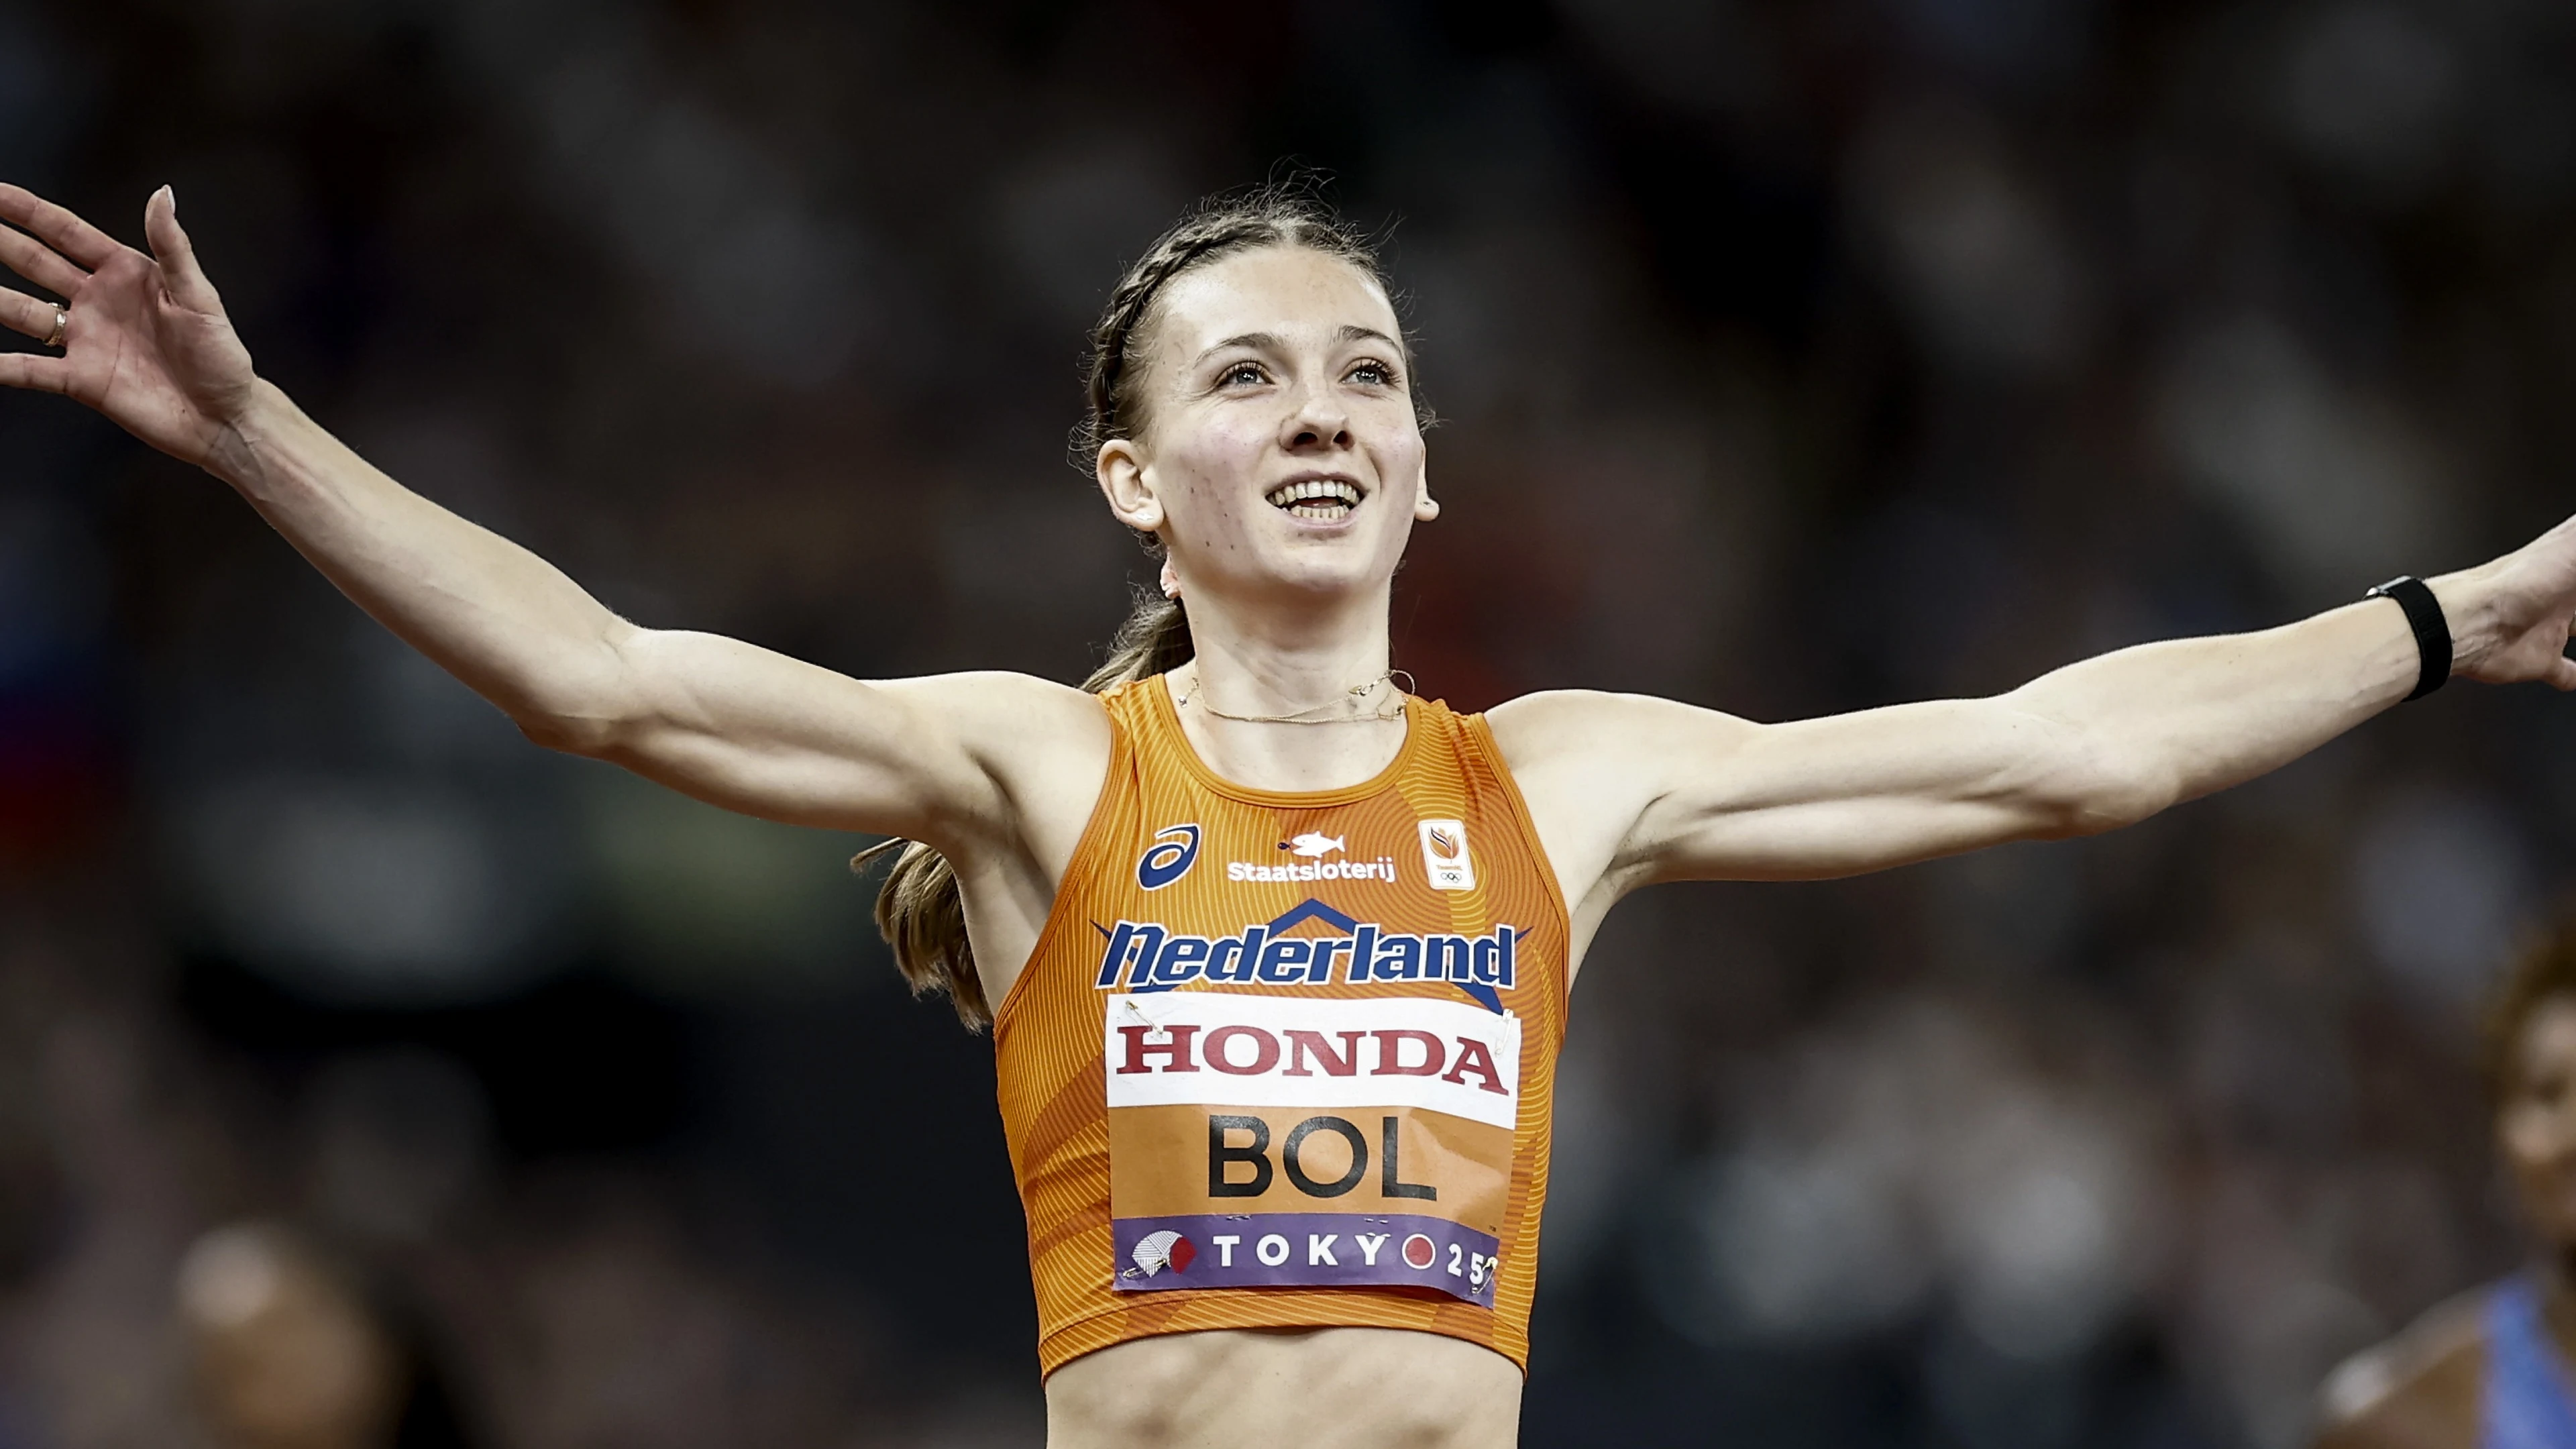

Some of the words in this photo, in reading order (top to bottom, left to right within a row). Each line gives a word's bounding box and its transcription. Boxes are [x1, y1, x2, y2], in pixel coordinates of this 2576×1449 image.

[1228, 857, 1396, 883] Staatsloterij
[1095, 920, 1515, 989] Nederland
[1116, 1024, 1509, 1095] HONDA
[1208, 1114, 1437, 1201] BOL
